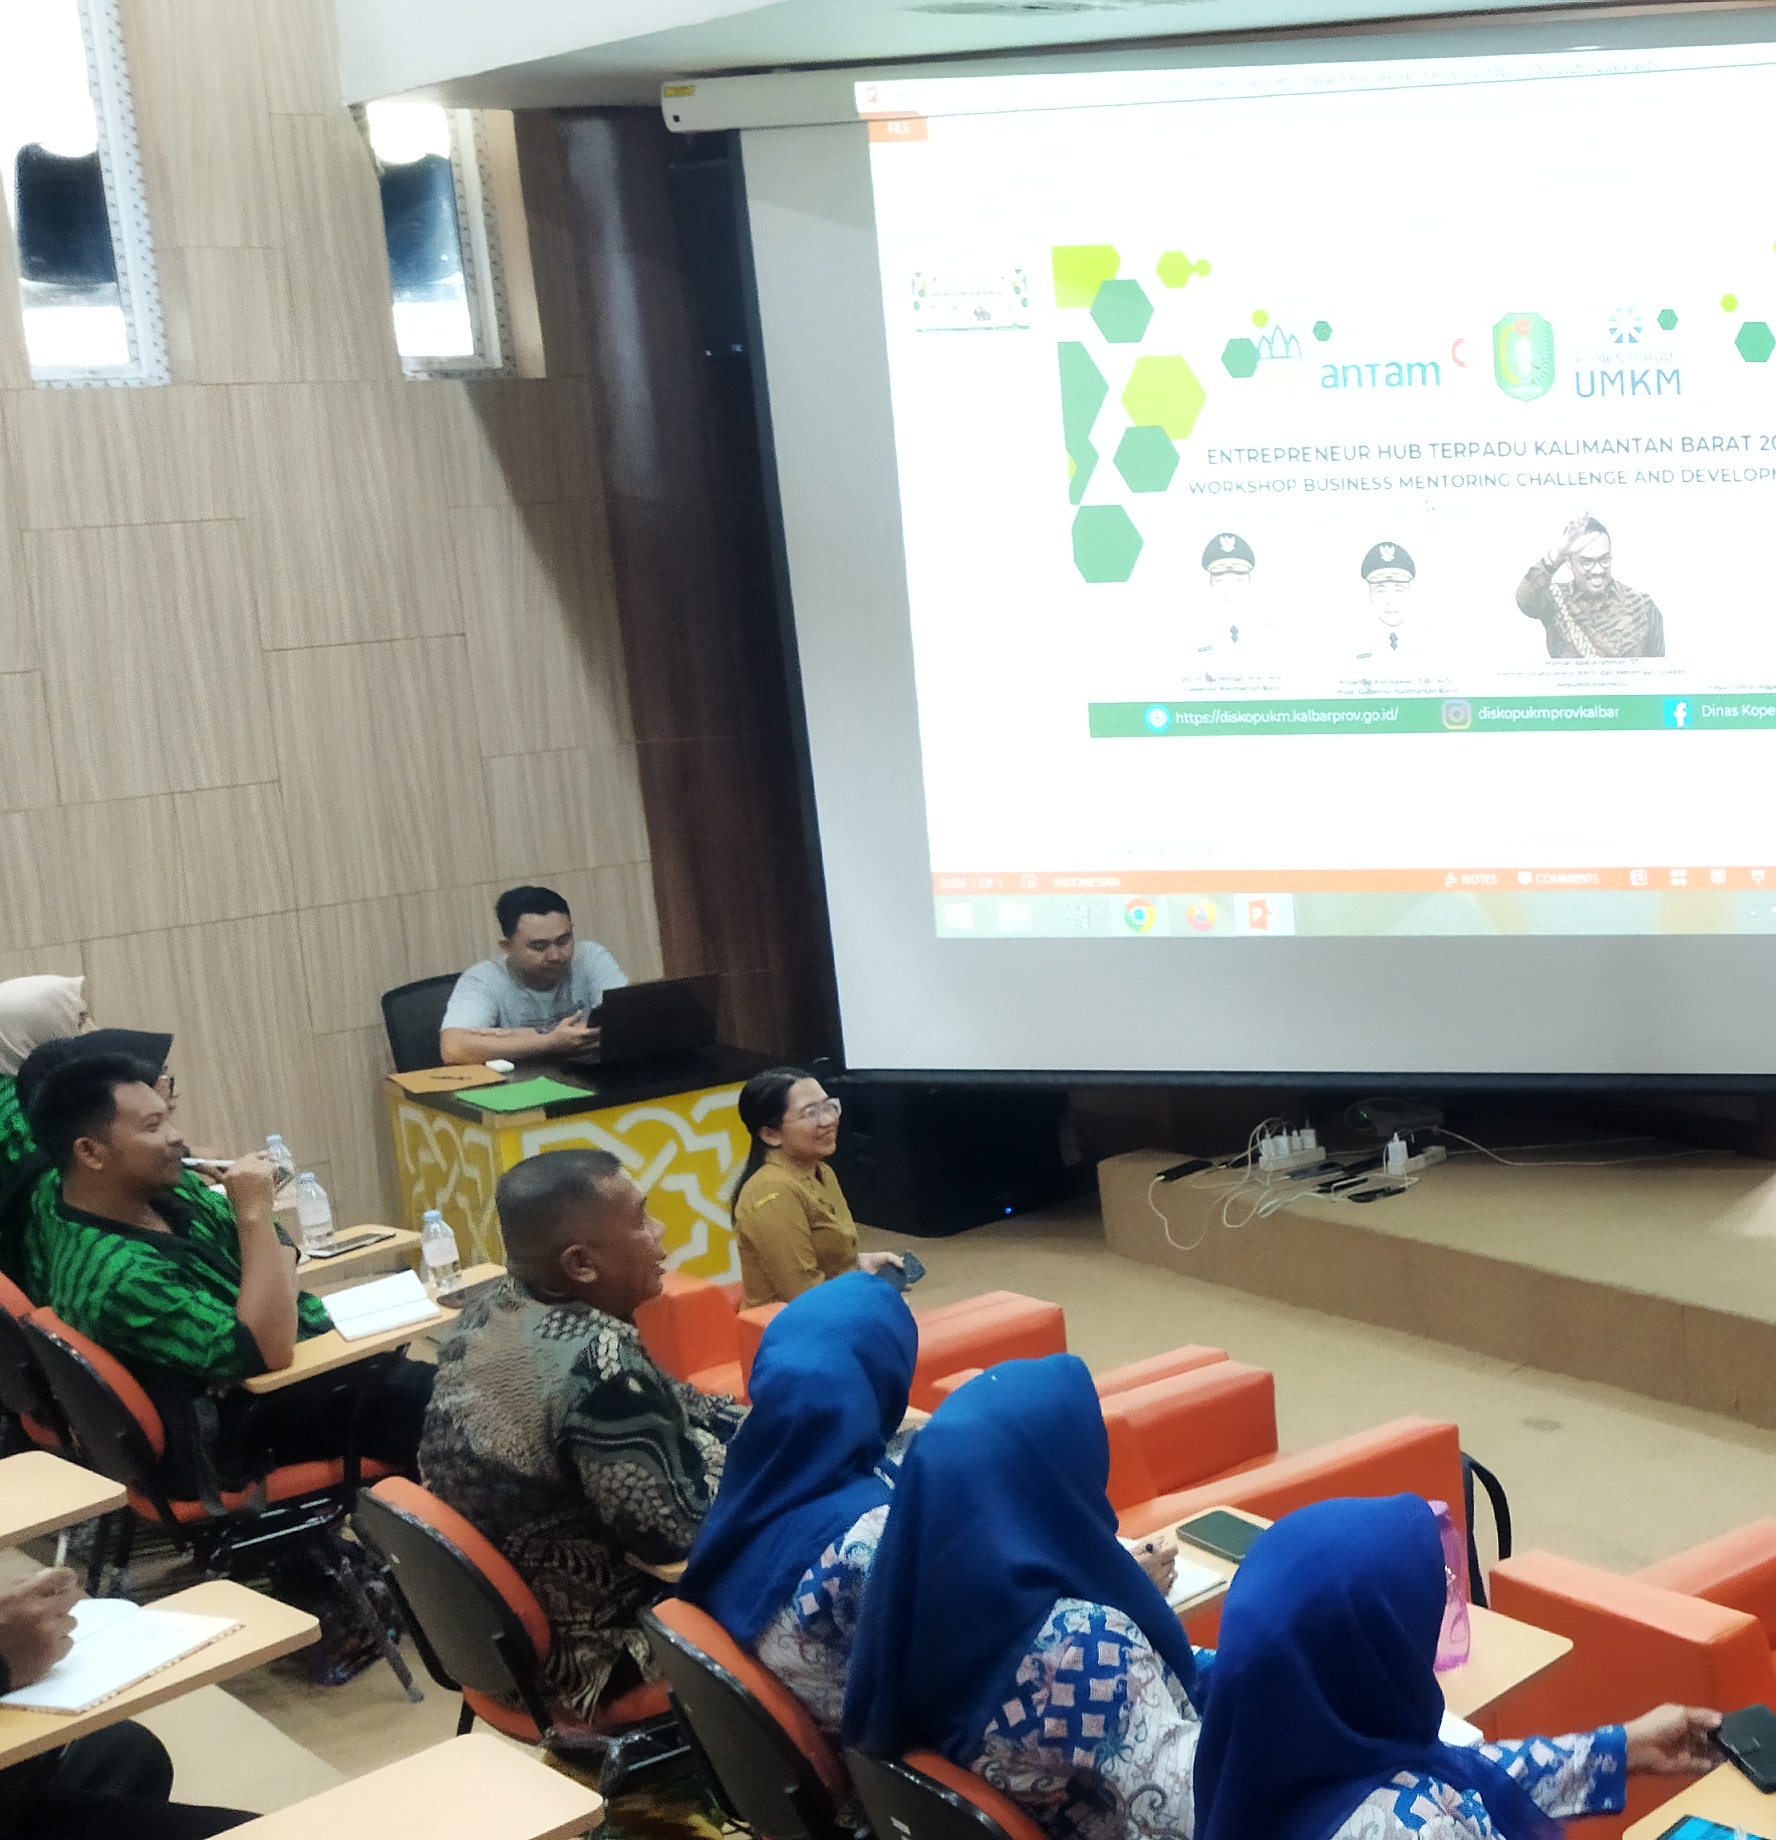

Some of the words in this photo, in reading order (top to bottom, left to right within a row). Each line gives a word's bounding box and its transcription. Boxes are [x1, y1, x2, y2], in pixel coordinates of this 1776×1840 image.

[1575, 368, 1682, 398] UMKM
[1207, 445, 1370, 465] ENTREPRENEUR
[1378, 444, 1422, 460] HUB
[1428, 441, 1527, 459] TERPADU
[1535, 437, 1673, 456] KALIMANTAN
[1681, 435, 1752, 453] BARAT
[1188, 479, 1297, 494] WORKSHOP
[1303, 477, 1393, 492] BUSINESS
[1399, 474, 1509, 490] MENTORING
[1516, 470, 1628, 487] CHALLENGE
[1634, 469, 1675, 484] AND
[1175, 706, 1399, 727] https://diskopukm.kalbarprov.go.id/
[1478, 705, 1620, 722] diskopukmprovkalbar
[1701, 703, 1739, 718] Dinas
[1461, 873, 1498, 884] NOTES
[1535, 873, 1600, 884] COMMENTS
